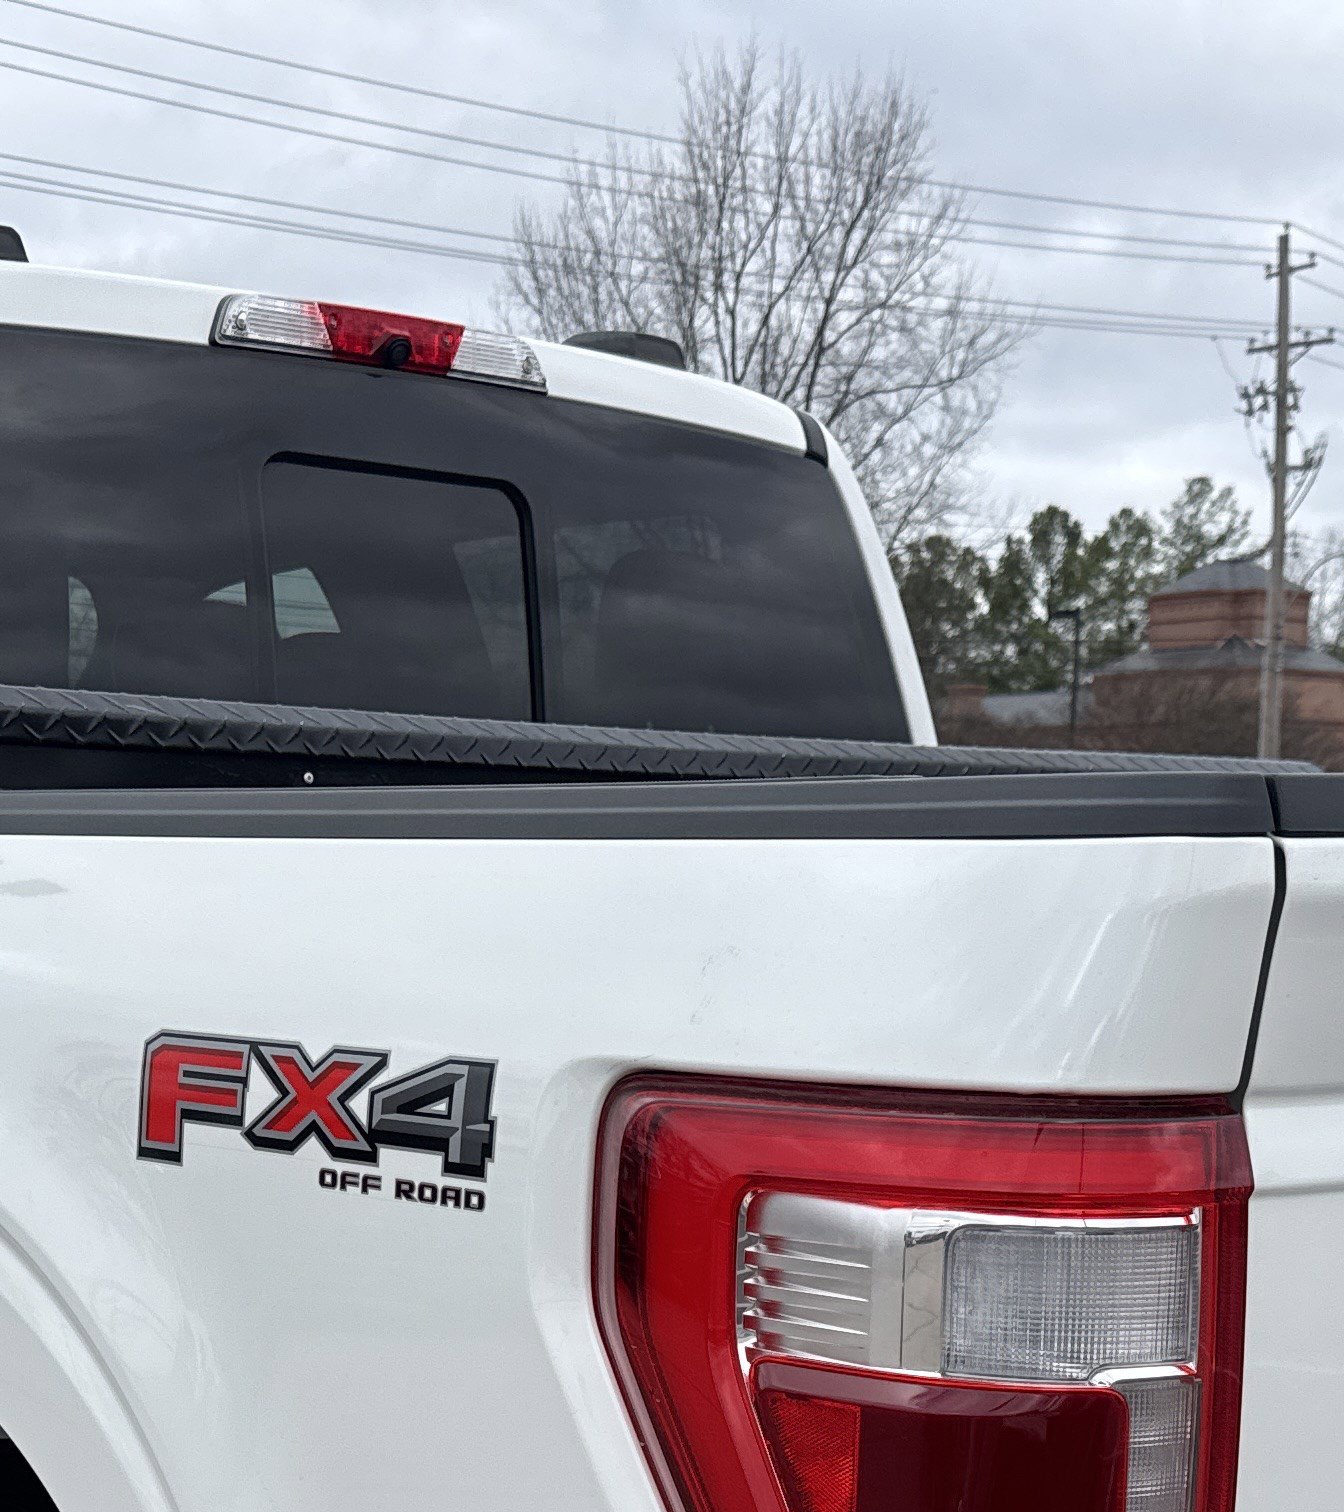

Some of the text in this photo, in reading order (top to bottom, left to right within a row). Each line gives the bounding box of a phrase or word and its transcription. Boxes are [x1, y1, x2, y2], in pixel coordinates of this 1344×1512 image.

[136, 1028, 499, 1182] FX4
[318, 1167, 486, 1212] OFF ROAD
